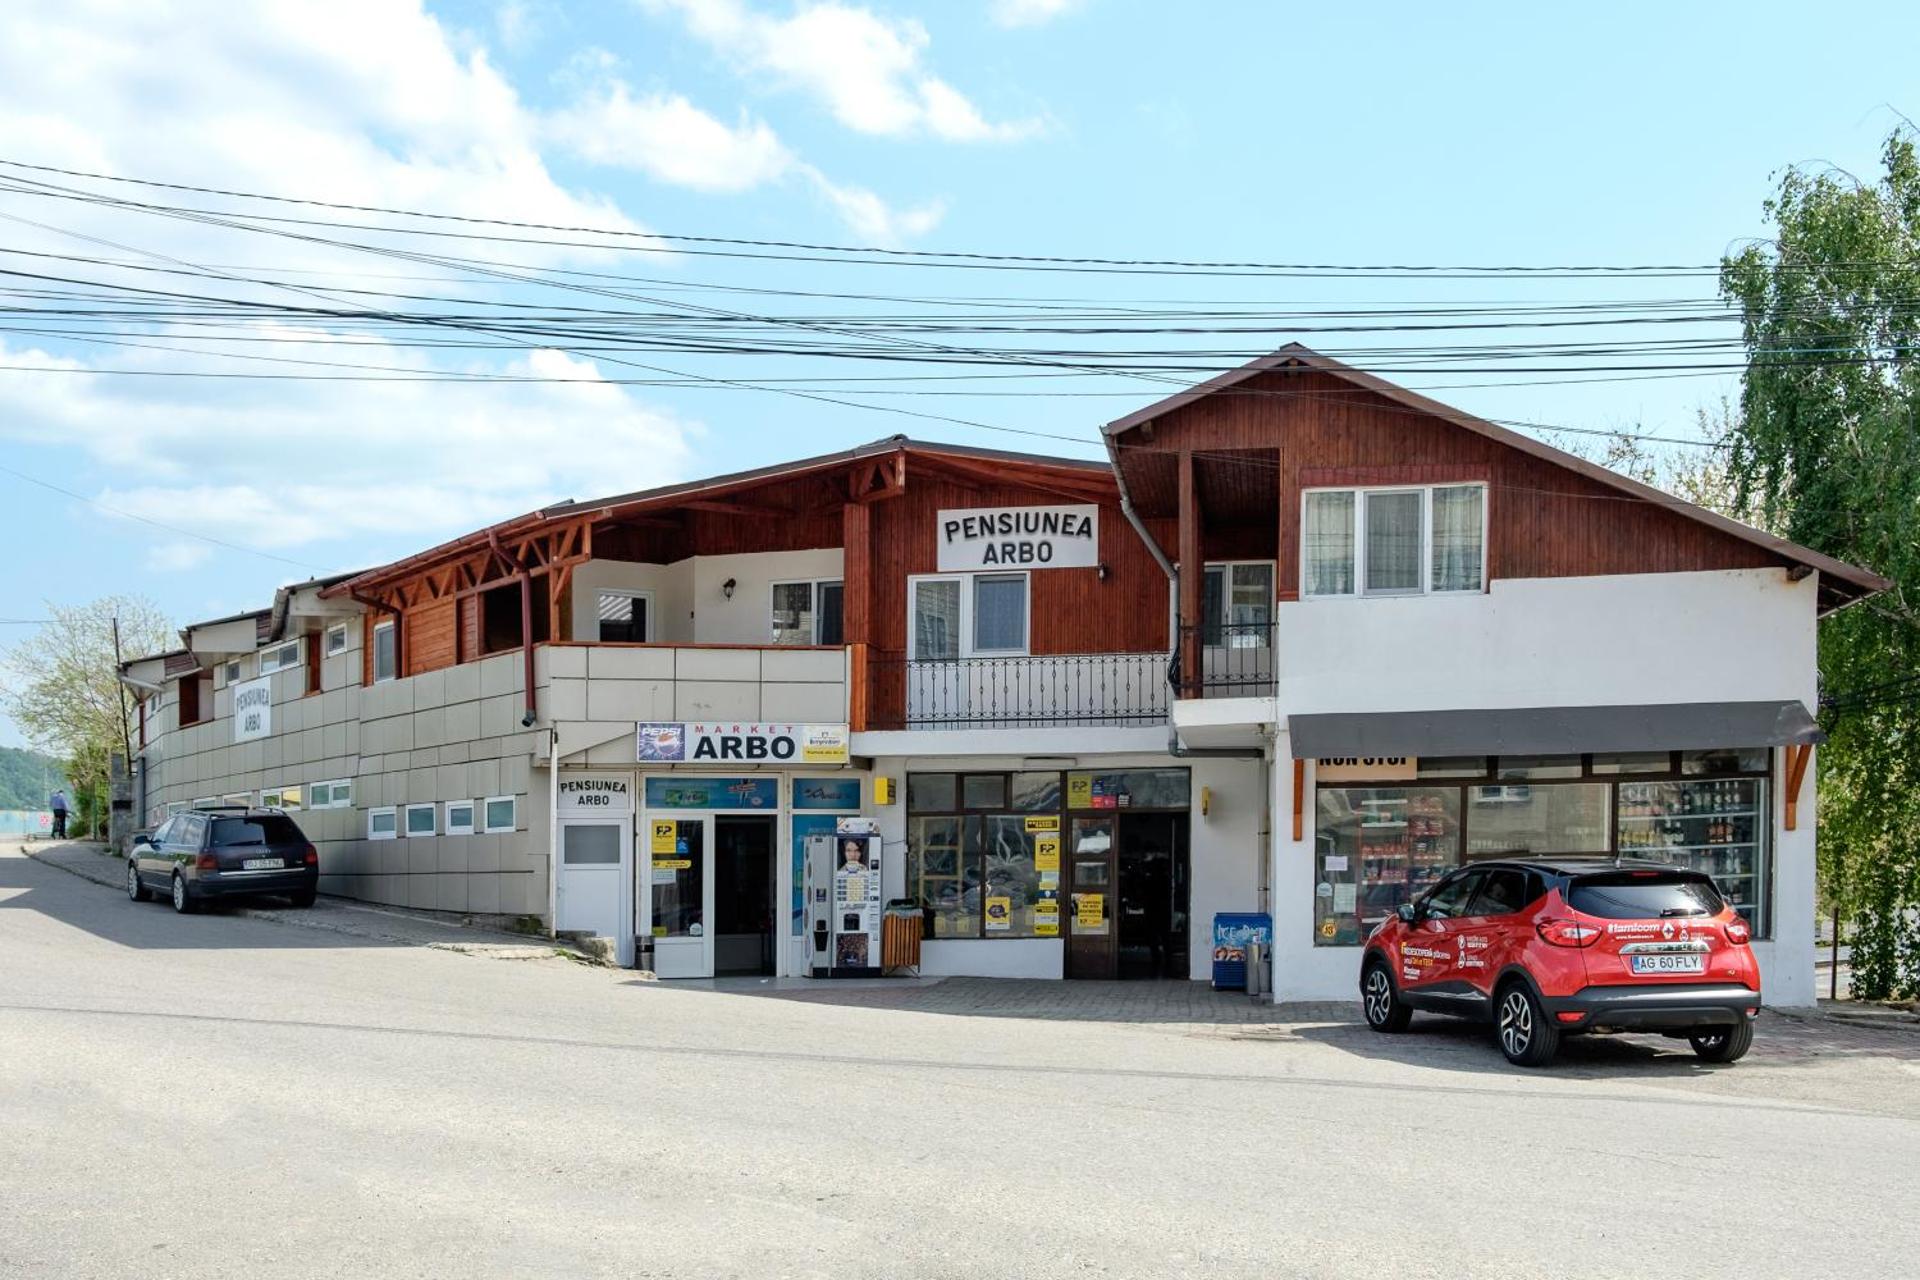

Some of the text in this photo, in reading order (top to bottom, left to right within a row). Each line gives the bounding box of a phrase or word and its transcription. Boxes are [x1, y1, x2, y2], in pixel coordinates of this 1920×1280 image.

[945, 512, 1093, 543] PENSIUNEA
[982, 541, 1053, 565] ARBO
[236, 688, 270, 715] PENSIUNEA
[244, 713, 260, 732] ARBO
[694, 725, 794, 734] MARKET
[641, 727, 681, 737] PEPSI
[693, 735, 796, 760] ARBO
[560, 780, 627, 794] PENSIUNEA
[578, 795, 609, 806] ARBO
[1640, 956, 1698, 969] AG 60 FLY
